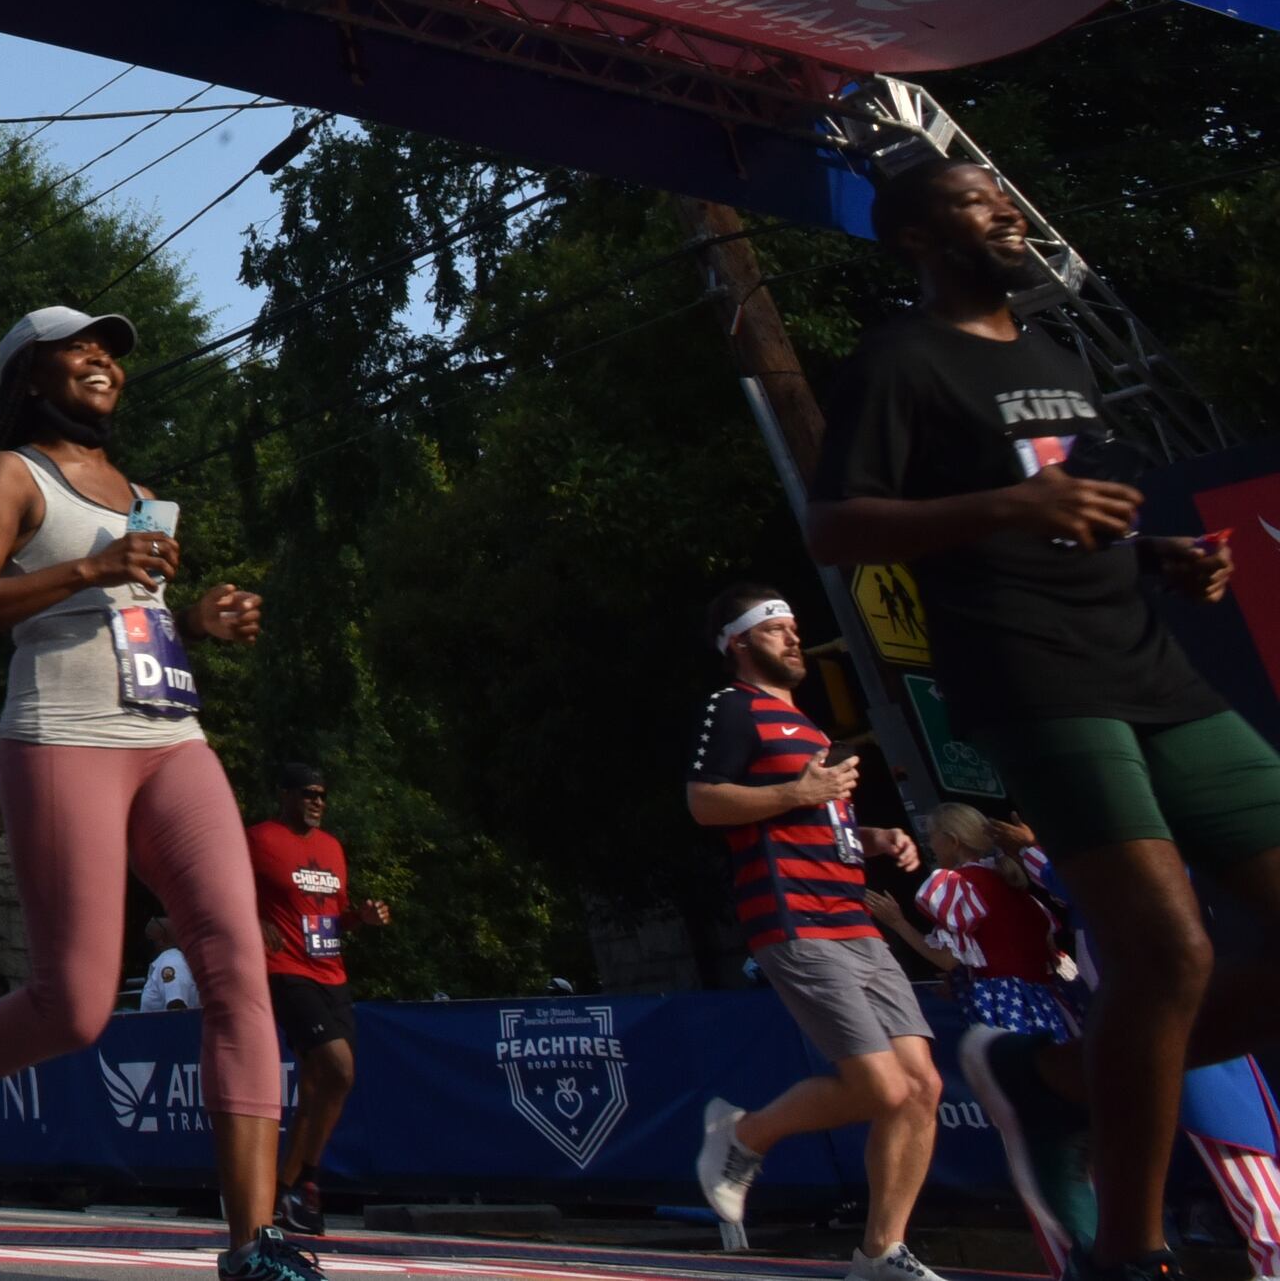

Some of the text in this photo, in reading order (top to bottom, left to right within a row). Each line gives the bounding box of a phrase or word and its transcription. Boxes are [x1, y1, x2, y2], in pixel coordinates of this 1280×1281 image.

[134, 653, 162, 686] D
[292, 872, 341, 890] CHICAGO
[496, 1036, 625, 1061] PEACHTREE
[527, 1060, 593, 1070] ROAD RACE
